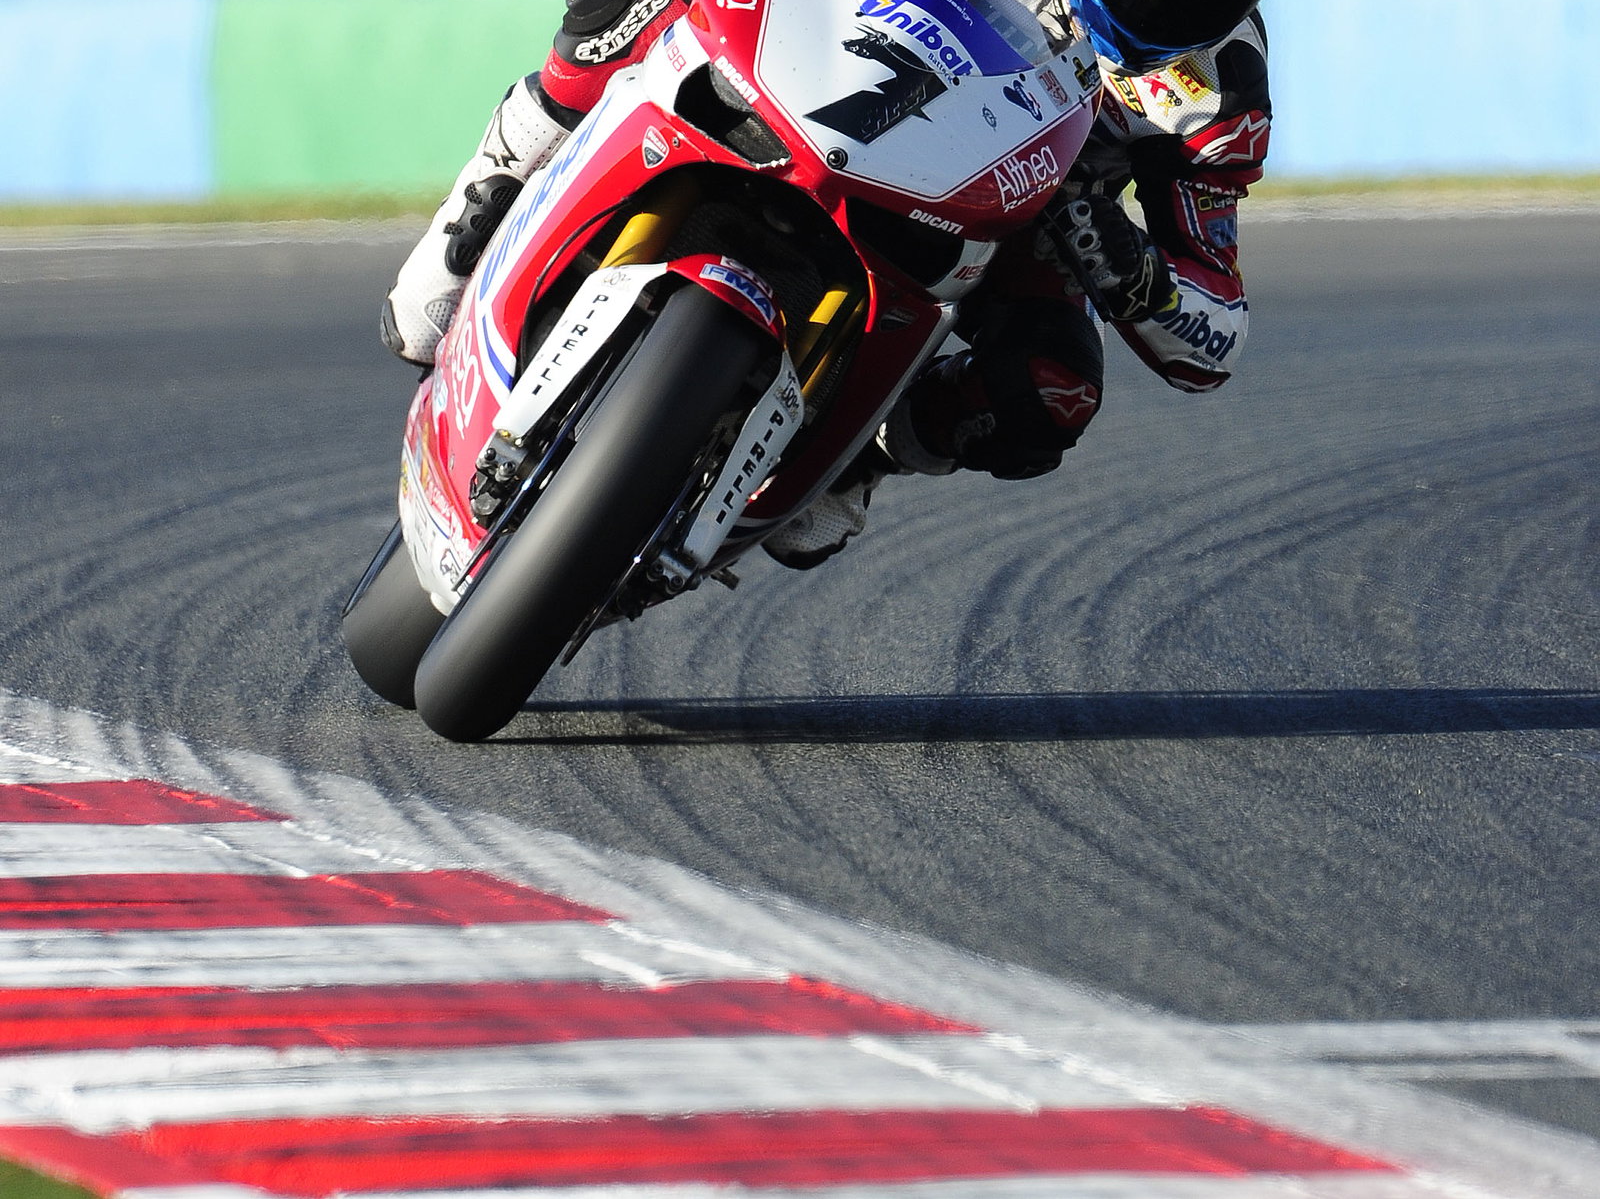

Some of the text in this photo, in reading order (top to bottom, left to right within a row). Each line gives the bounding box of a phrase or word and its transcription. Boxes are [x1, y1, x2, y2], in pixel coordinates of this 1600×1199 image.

[712, 55, 760, 103] DUCATI
[993, 145, 1059, 206] Althea
[1003, 177, 1060, 214] Racing
[908, 208, 965, 235] DUCATI
[531, 293, 610, 397] PIRELLI
[715, 409, 785, 526] PIRELLI
